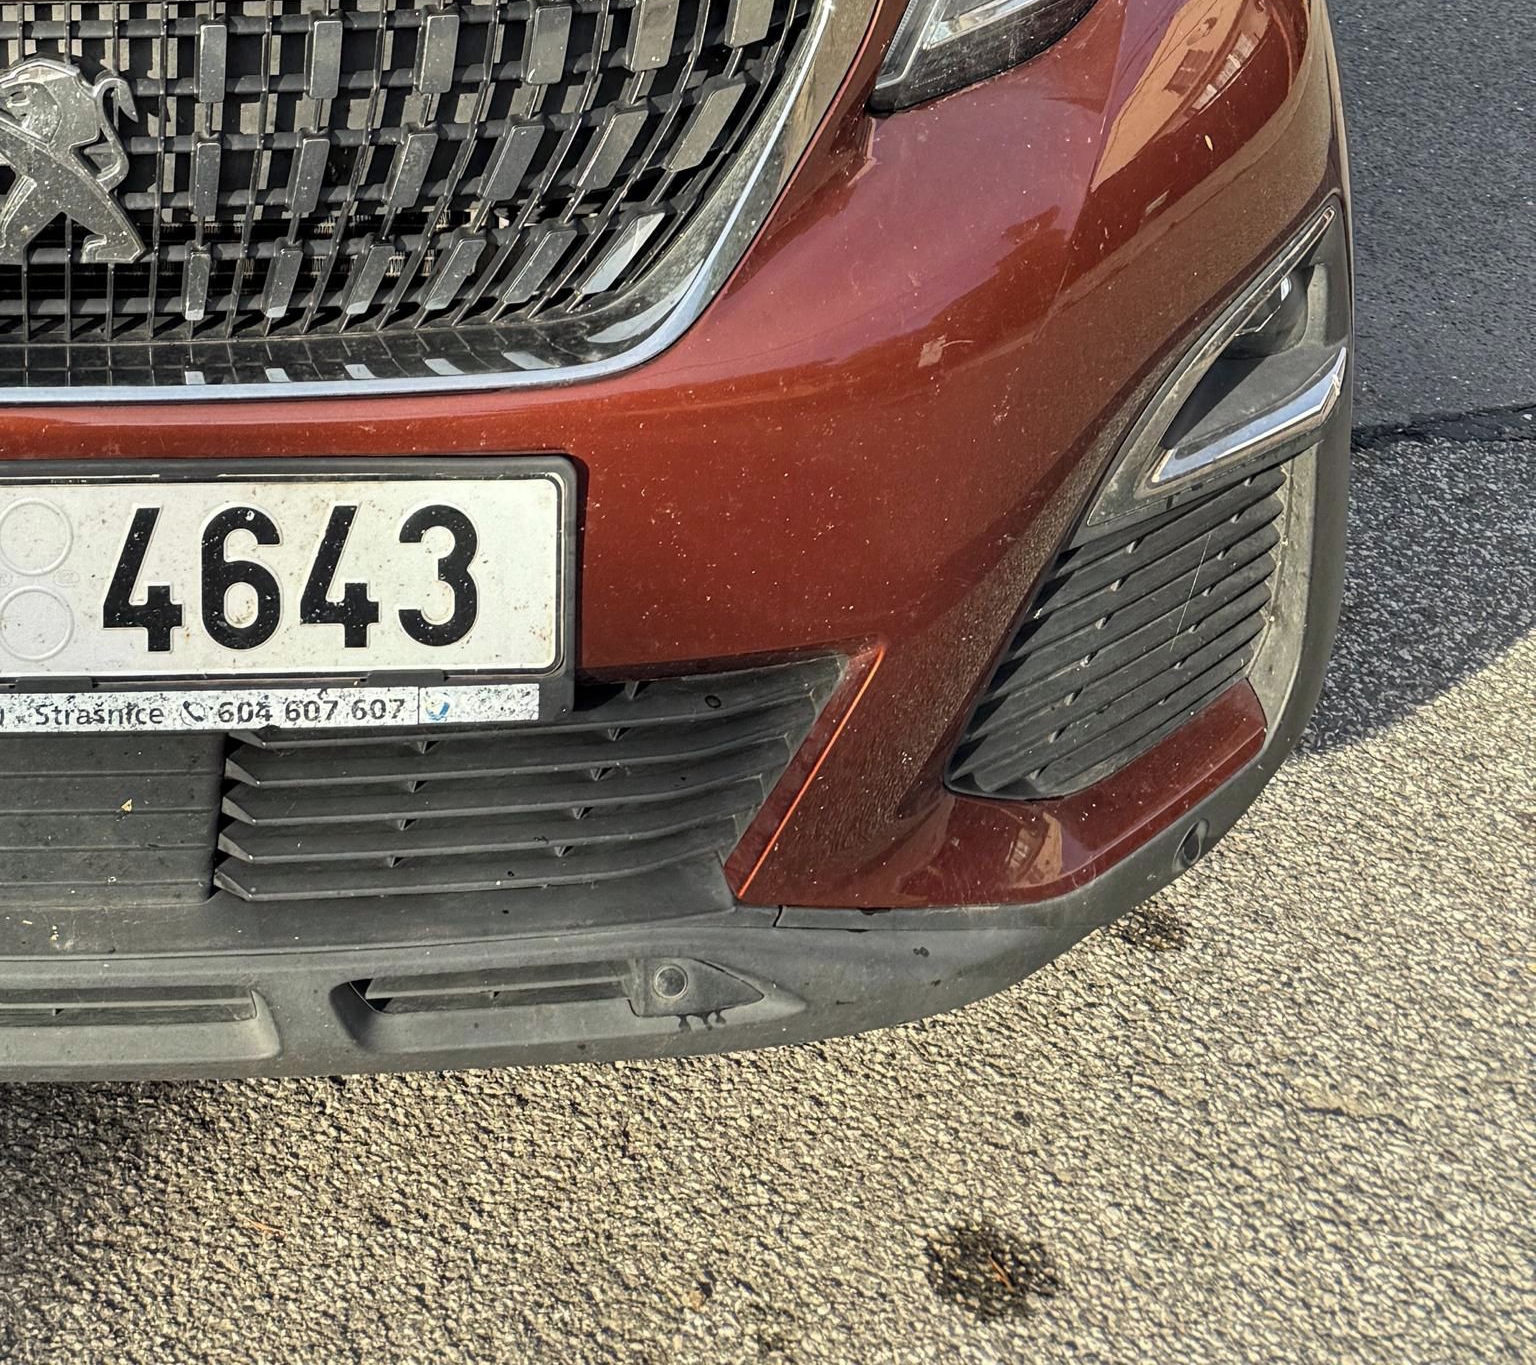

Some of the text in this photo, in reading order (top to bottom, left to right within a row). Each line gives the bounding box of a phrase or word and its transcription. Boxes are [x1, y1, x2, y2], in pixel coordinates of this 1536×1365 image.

[102, 503, 479, 652] 4643
[35, 702, 165, 726] Strašnice
[218, 700, 273, 723] 604
[285, 699, 339, 722] 607
[352, 698, 406, 720] 607
